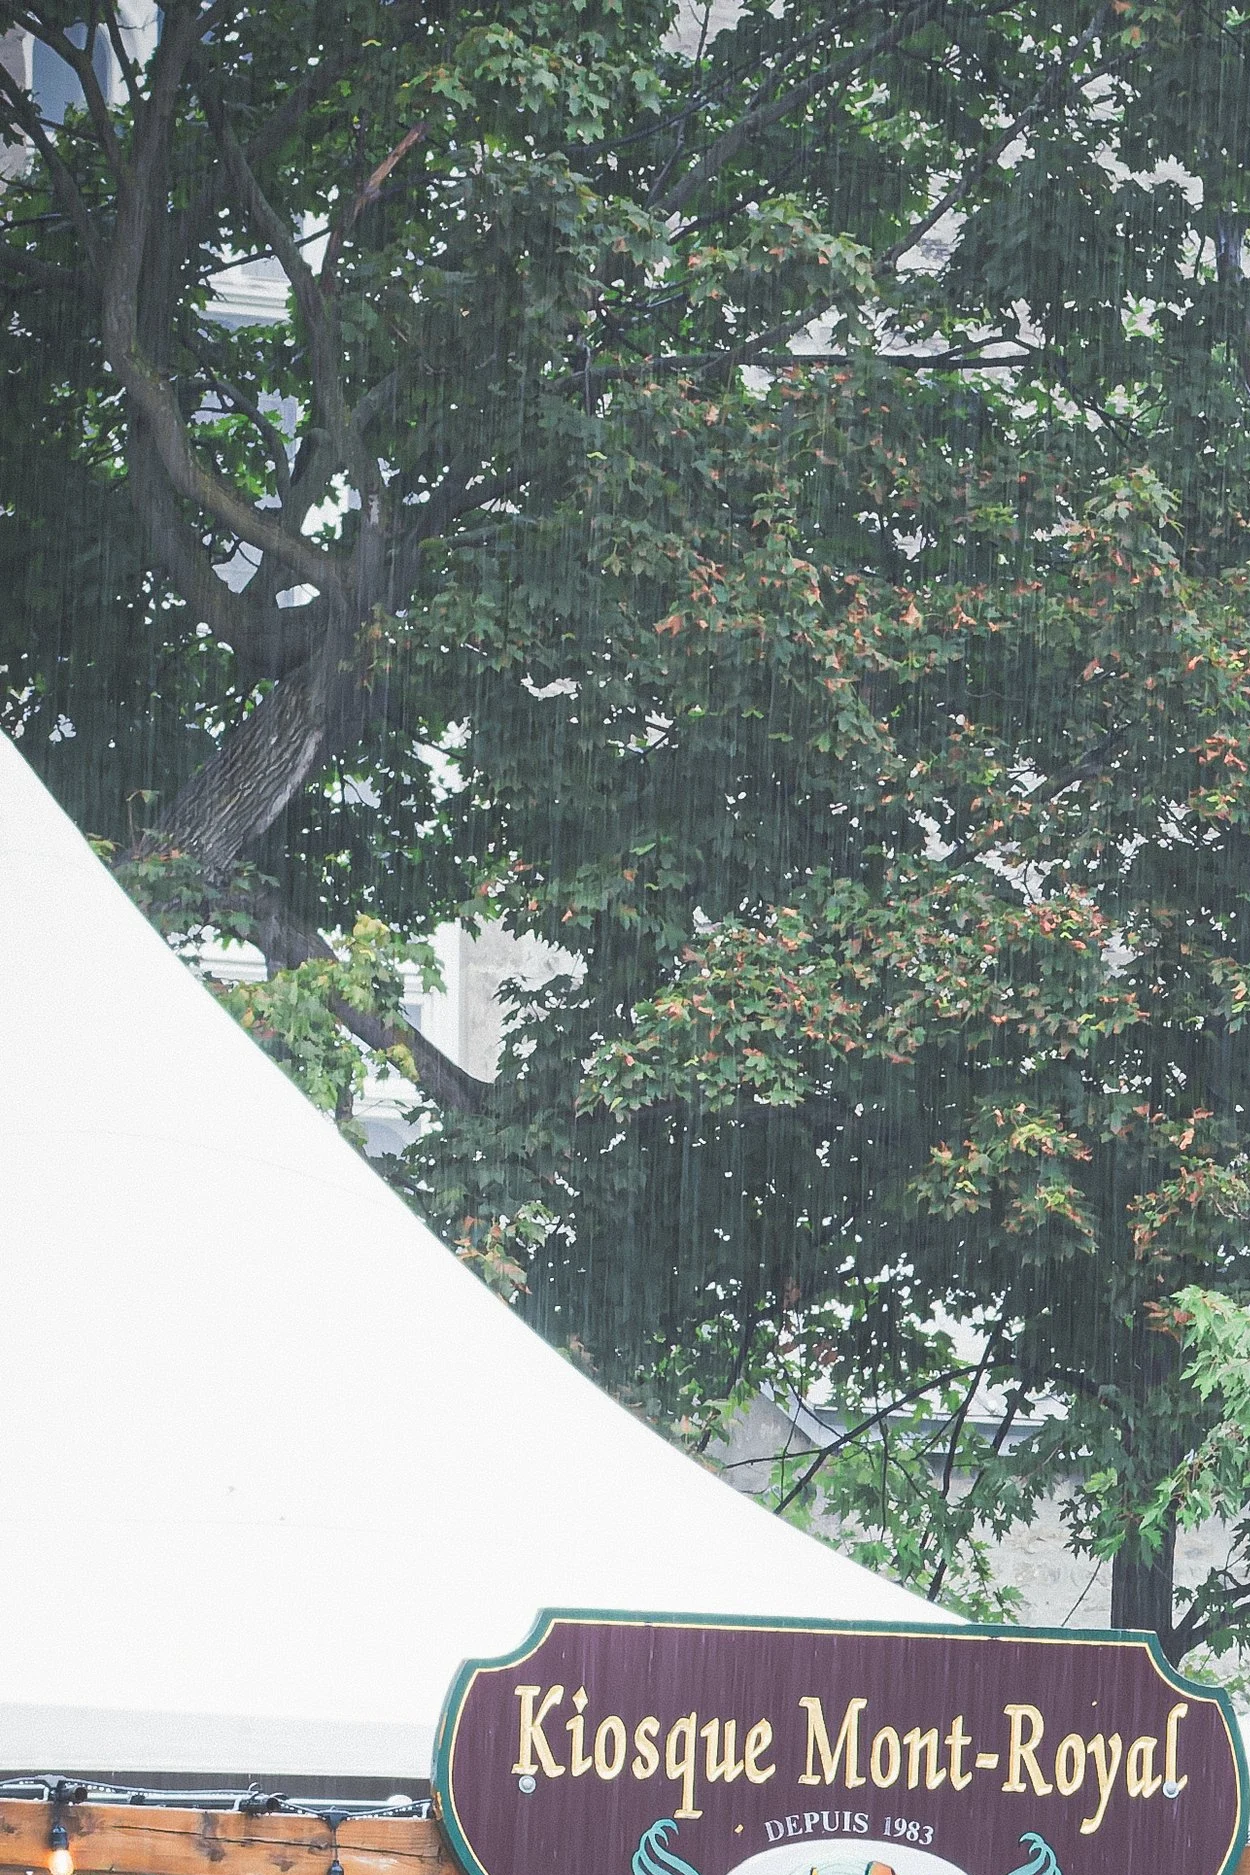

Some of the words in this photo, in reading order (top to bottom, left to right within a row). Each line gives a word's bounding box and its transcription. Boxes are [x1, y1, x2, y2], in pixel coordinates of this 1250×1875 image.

[511, 1684, 776, 1820] Kiosque
[797, 1696, 1189, 1835] Mont-Royal
[763, 1811, 869, 1843] DEPUIS
[882, 1816, 934, 1845] 1983
